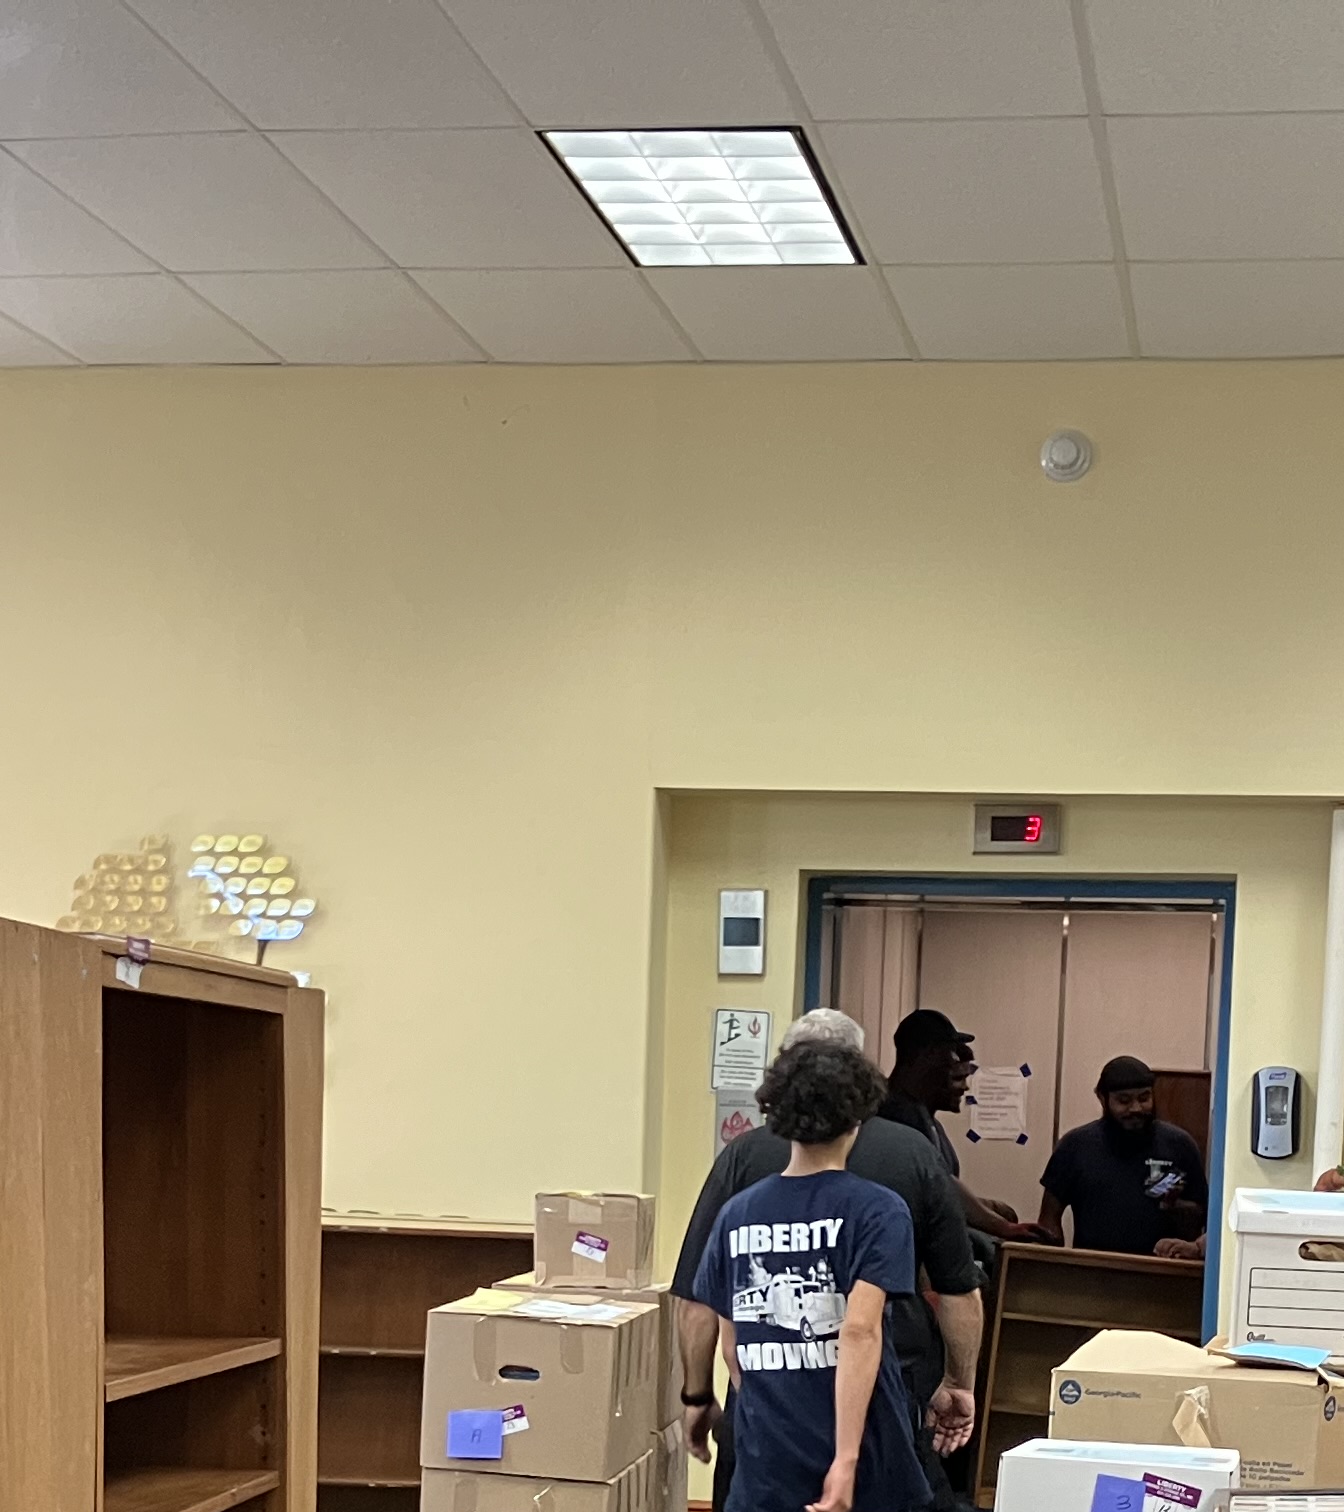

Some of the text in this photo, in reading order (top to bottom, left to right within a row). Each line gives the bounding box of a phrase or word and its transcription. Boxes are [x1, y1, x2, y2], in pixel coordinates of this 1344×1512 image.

[1024, 816, 1041, 841] 3
[1157, 1479, 1187, 1493] LIBERTY
[1116, 1495, 1131, 1510] 3
